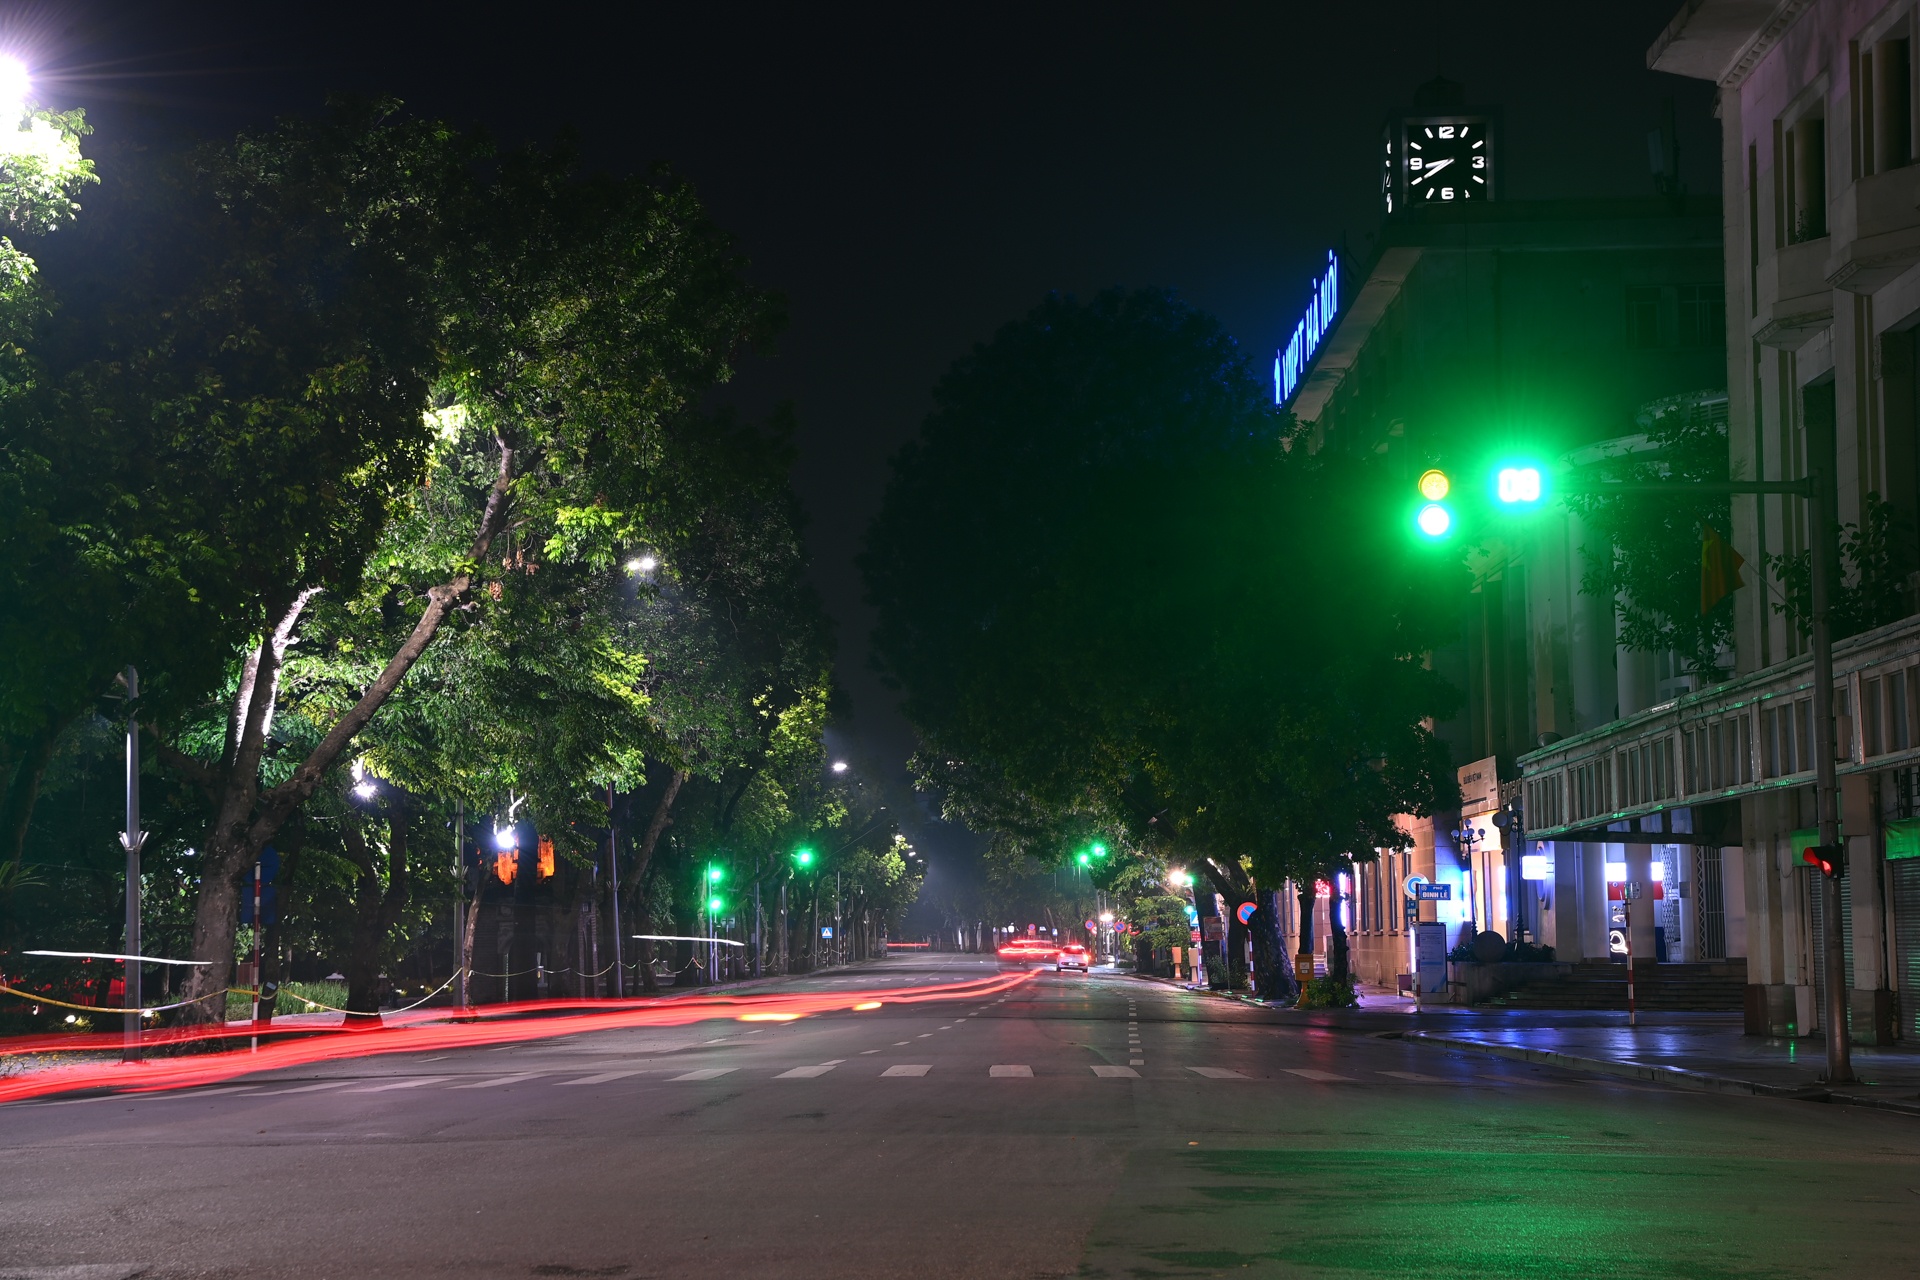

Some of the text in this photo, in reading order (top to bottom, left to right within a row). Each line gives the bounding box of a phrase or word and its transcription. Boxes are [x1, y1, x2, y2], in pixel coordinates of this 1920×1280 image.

[1438, 126, 1454, 139] 12
[1409, 157, 1422, 171] 9
[1472, 155, 1485, 169] 3
[1441, 187, 1454, 200] 6
[1306, 278, 1320, 362] HÀ
